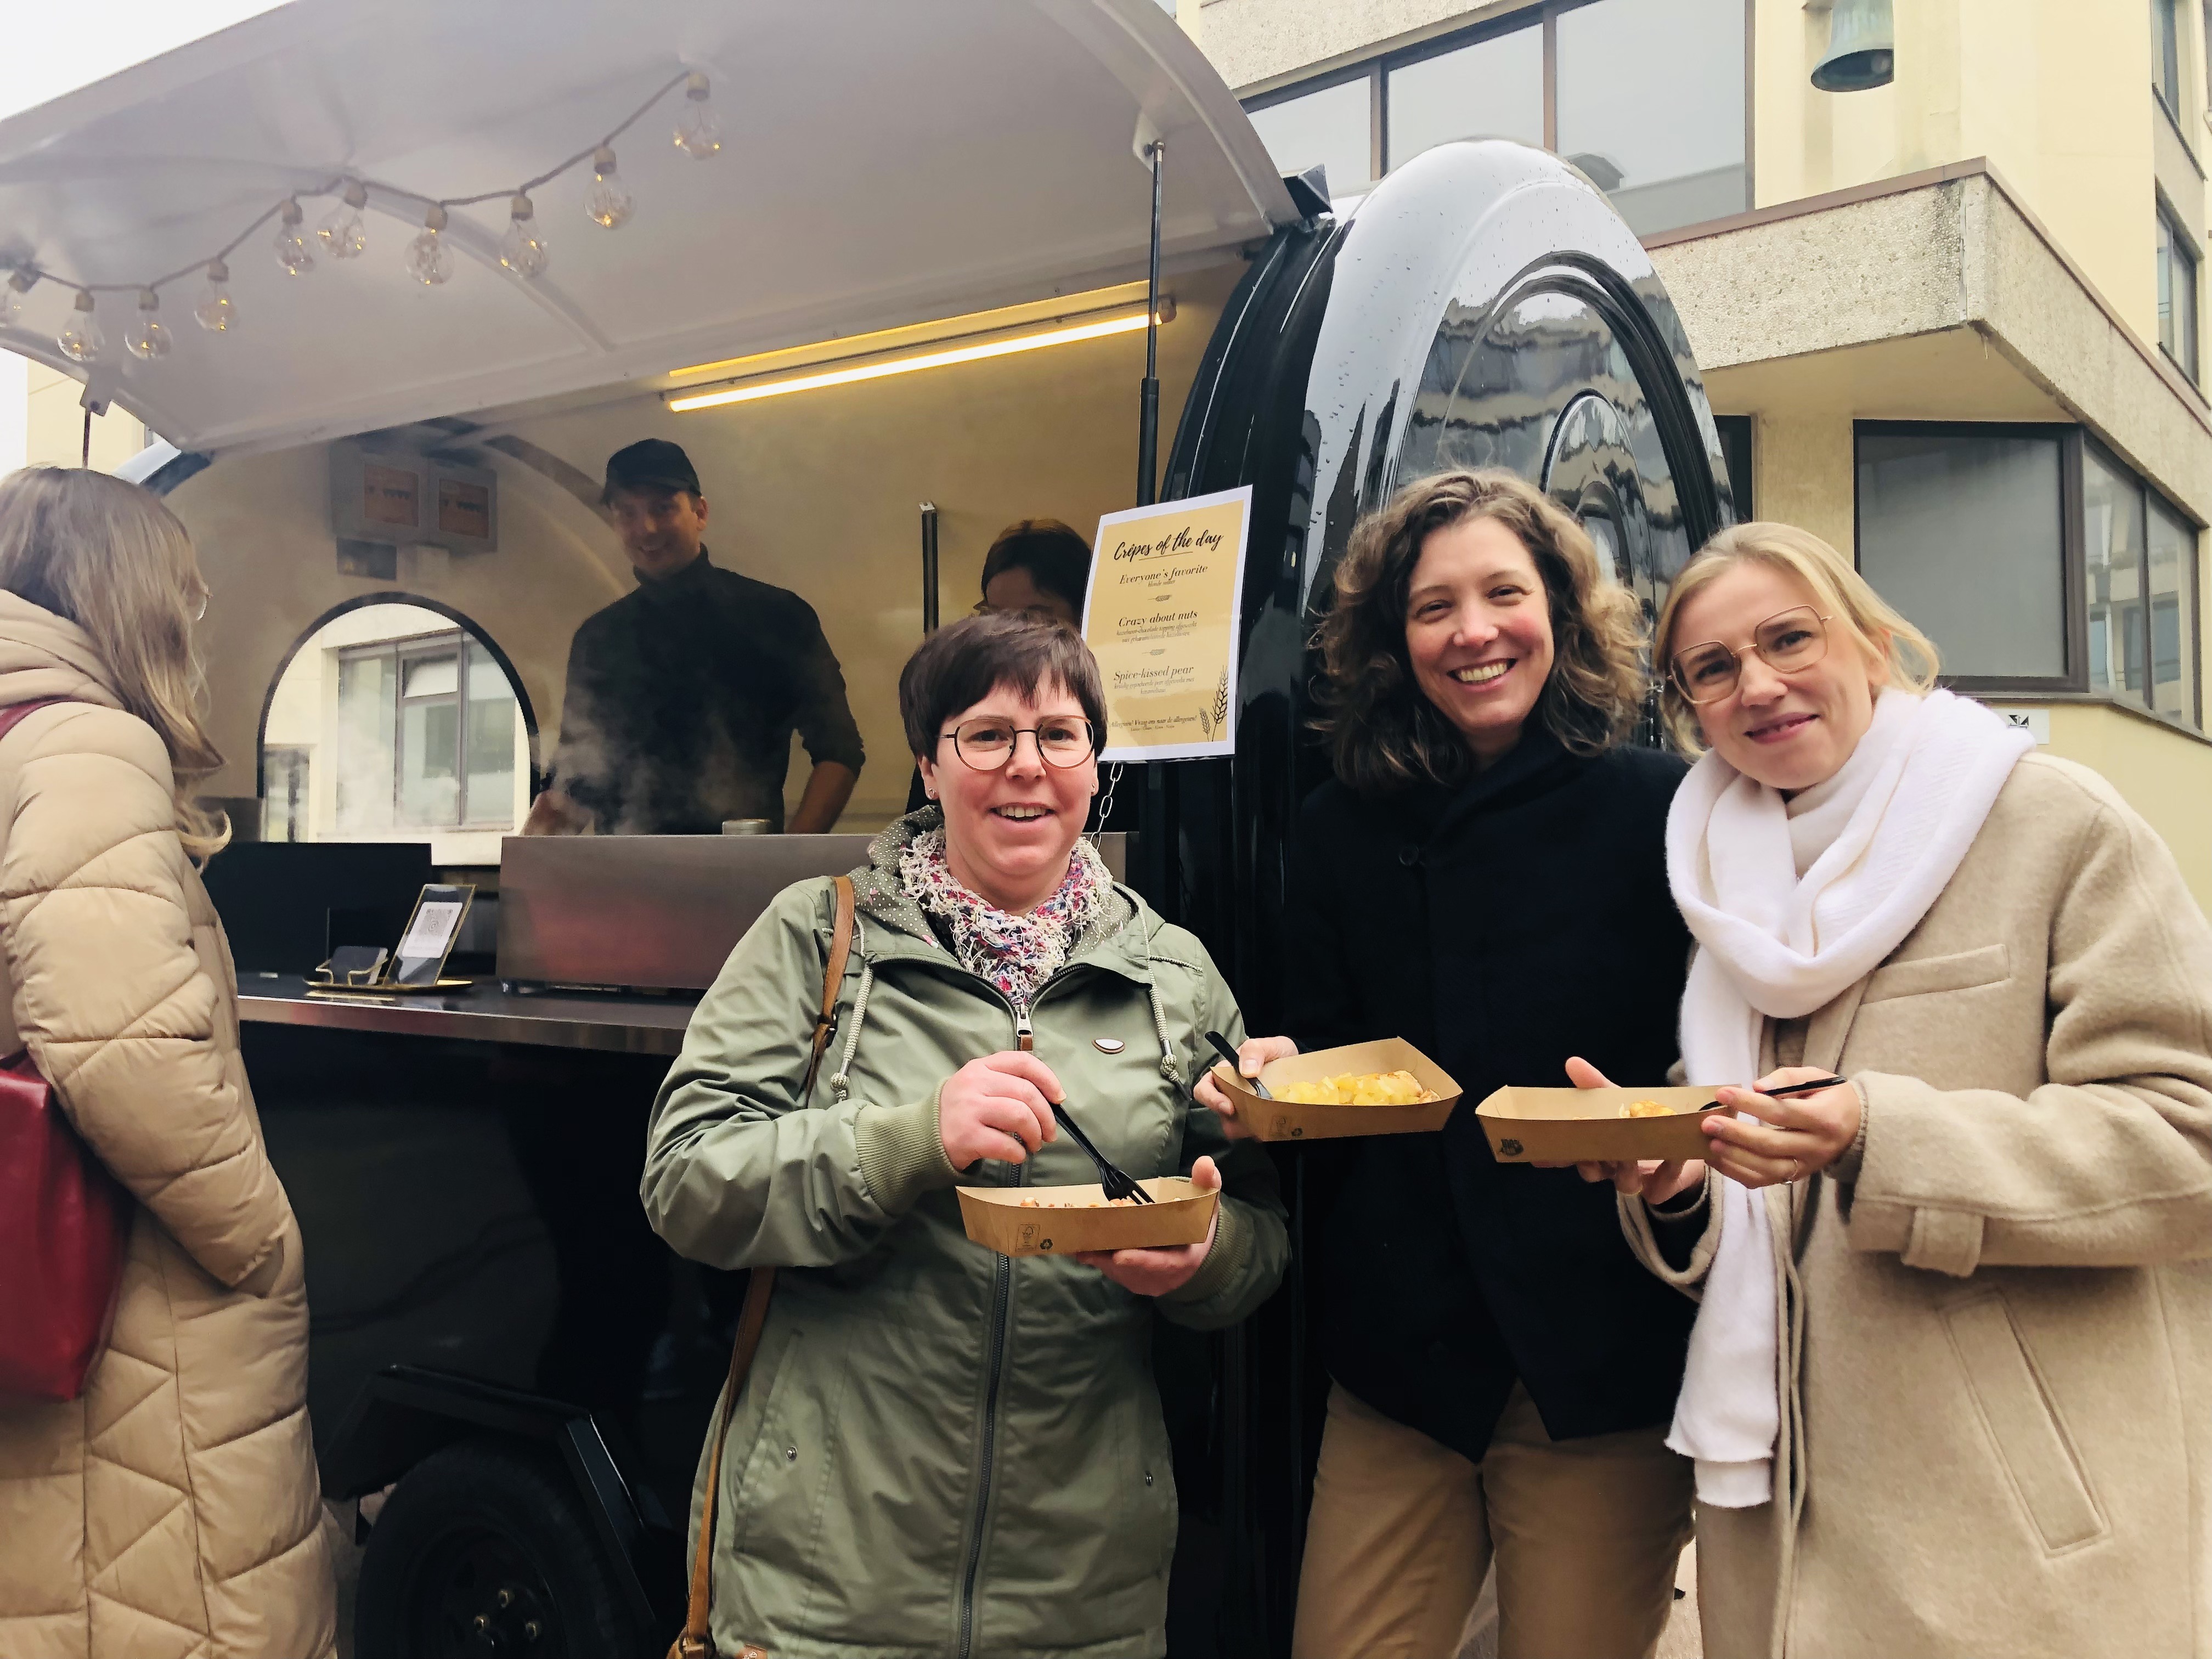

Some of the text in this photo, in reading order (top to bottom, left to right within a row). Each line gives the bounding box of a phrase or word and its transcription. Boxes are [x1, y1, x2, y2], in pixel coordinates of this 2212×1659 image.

[1114, 527, 1224, 562] Crêpes of the day
[1169, 565, 1208, 580] favorite
[1119, 610, 1198, 627] Crazy about nuts
[1114, 665, 1194, 684] Spice-kissed pear
